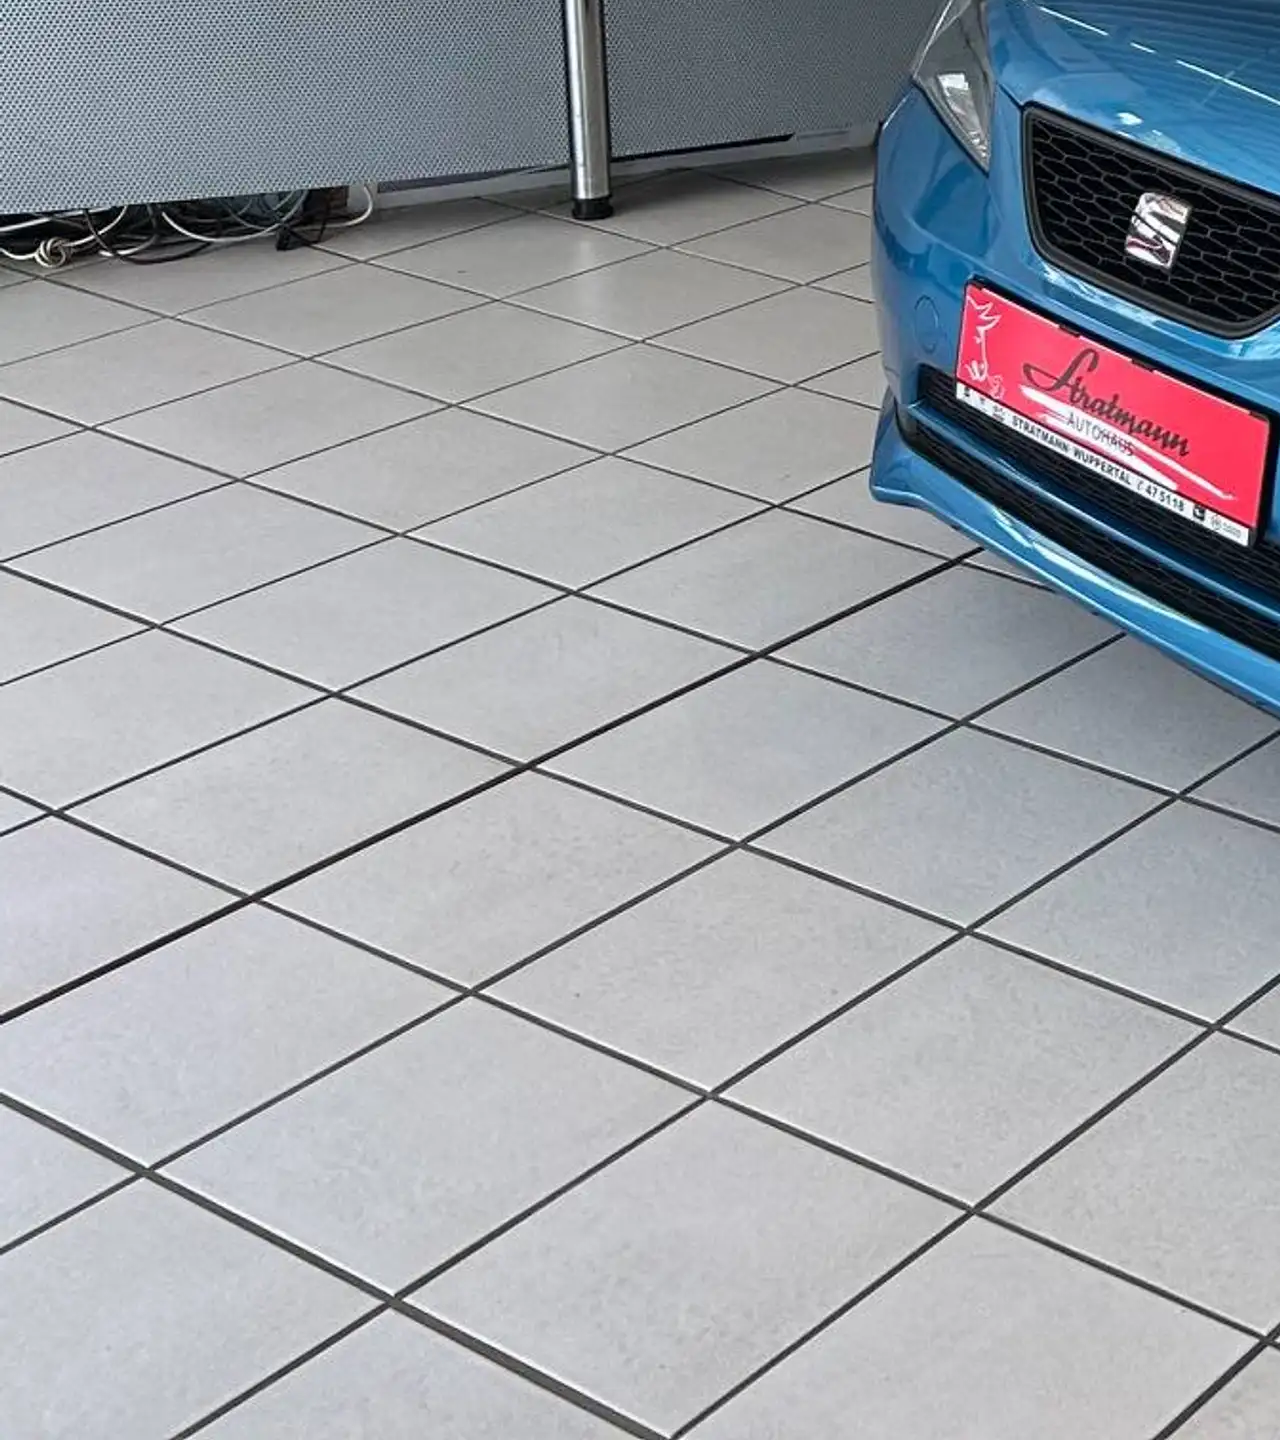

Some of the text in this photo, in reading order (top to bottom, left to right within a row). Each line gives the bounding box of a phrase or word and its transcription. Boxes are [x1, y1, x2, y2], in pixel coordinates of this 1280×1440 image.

[1022, 348, 1190, 457] Stratmann
[1067, 412, 1135, 457] AUTOHAUS
[1074, 448, 1132, 486] WUPPERTAL
